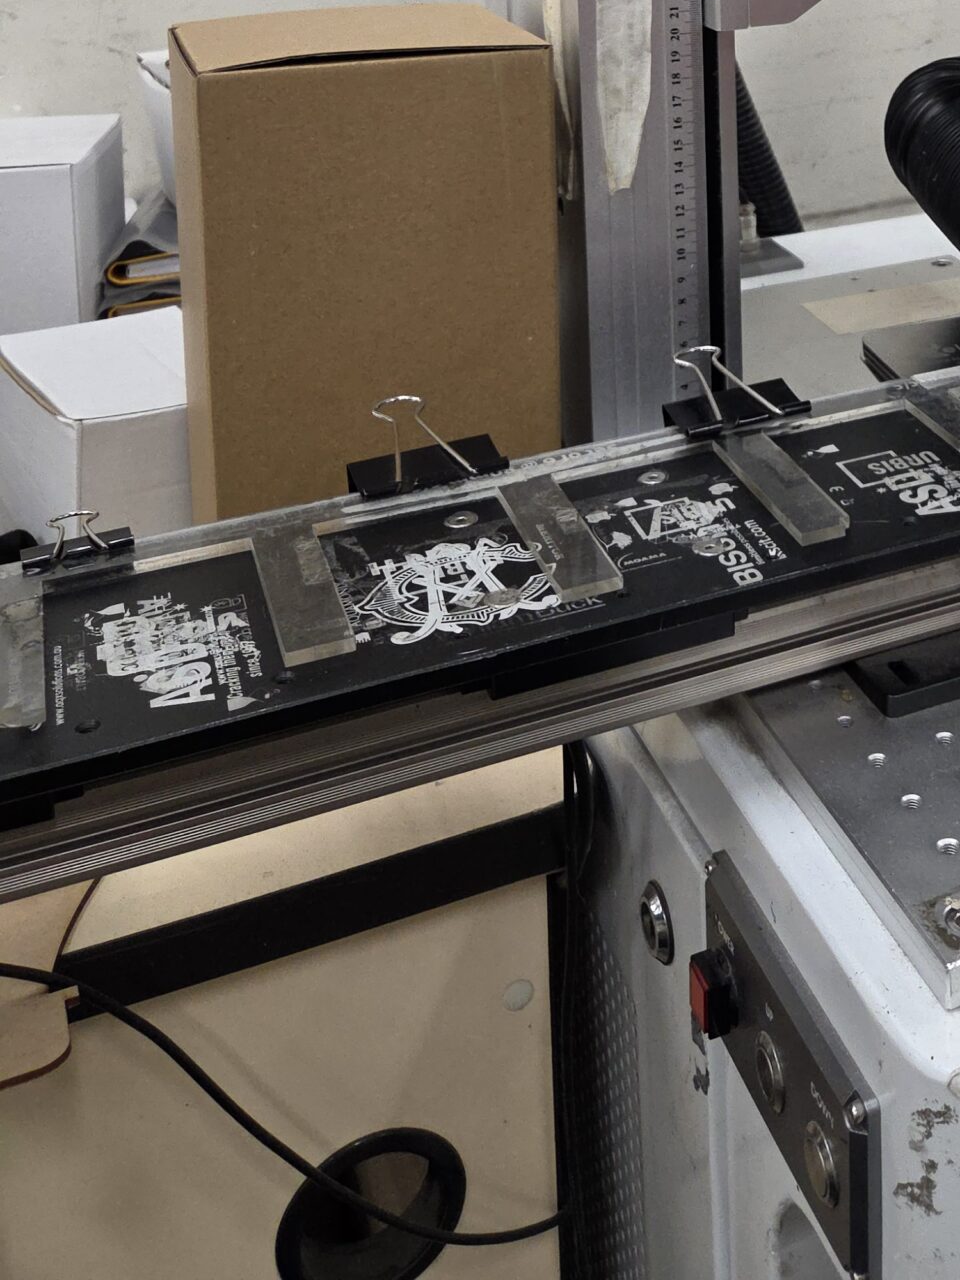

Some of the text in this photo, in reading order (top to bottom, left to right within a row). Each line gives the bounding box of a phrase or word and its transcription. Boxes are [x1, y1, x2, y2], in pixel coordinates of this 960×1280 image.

[670, 6, 679, 19] 21
[671, 28, 680, 41] 20
[671, 50, 681, 63] 19
[672, 72, 681, 85] 18
[672, 95, 682, 108] 17
[673, 117, 682, 129] 16
[674, 139, 683, 152] 15
[674, 161, 684, 173] 14
[675, 183, 684, 195] 13
[675, 205, 685, 217] 12
[676, 227, 685, 239] 11
[677, 248, 686, 261] 10
[868, 450, 941, 475] URBIS
[623, 552, 668, 566] MOAMA
